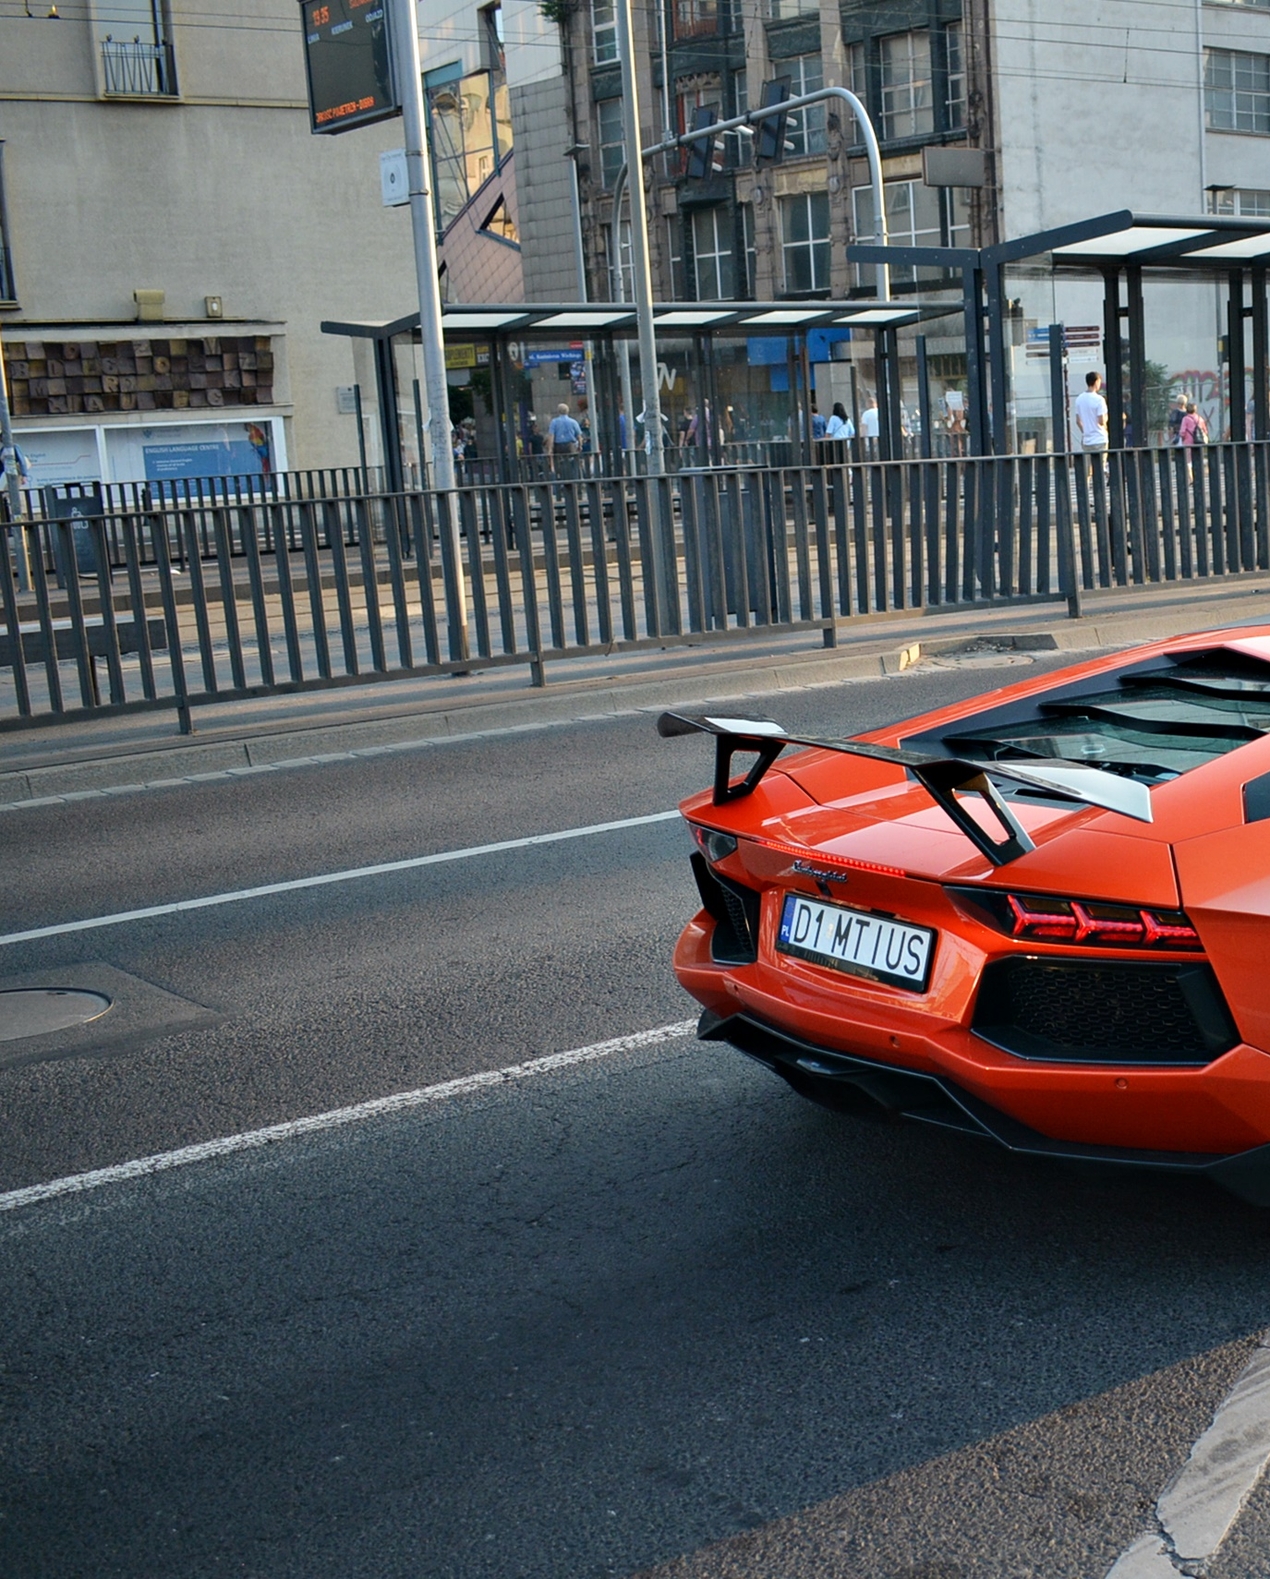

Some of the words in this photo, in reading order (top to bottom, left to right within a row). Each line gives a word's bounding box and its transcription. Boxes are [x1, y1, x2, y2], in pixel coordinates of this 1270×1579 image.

[169, 445, 199, 453] LANGUAGE
[780, 925, 790, 937] PL
[793, 904, 824, 949] D1
[830, 914, 925, 976] MTIUS
